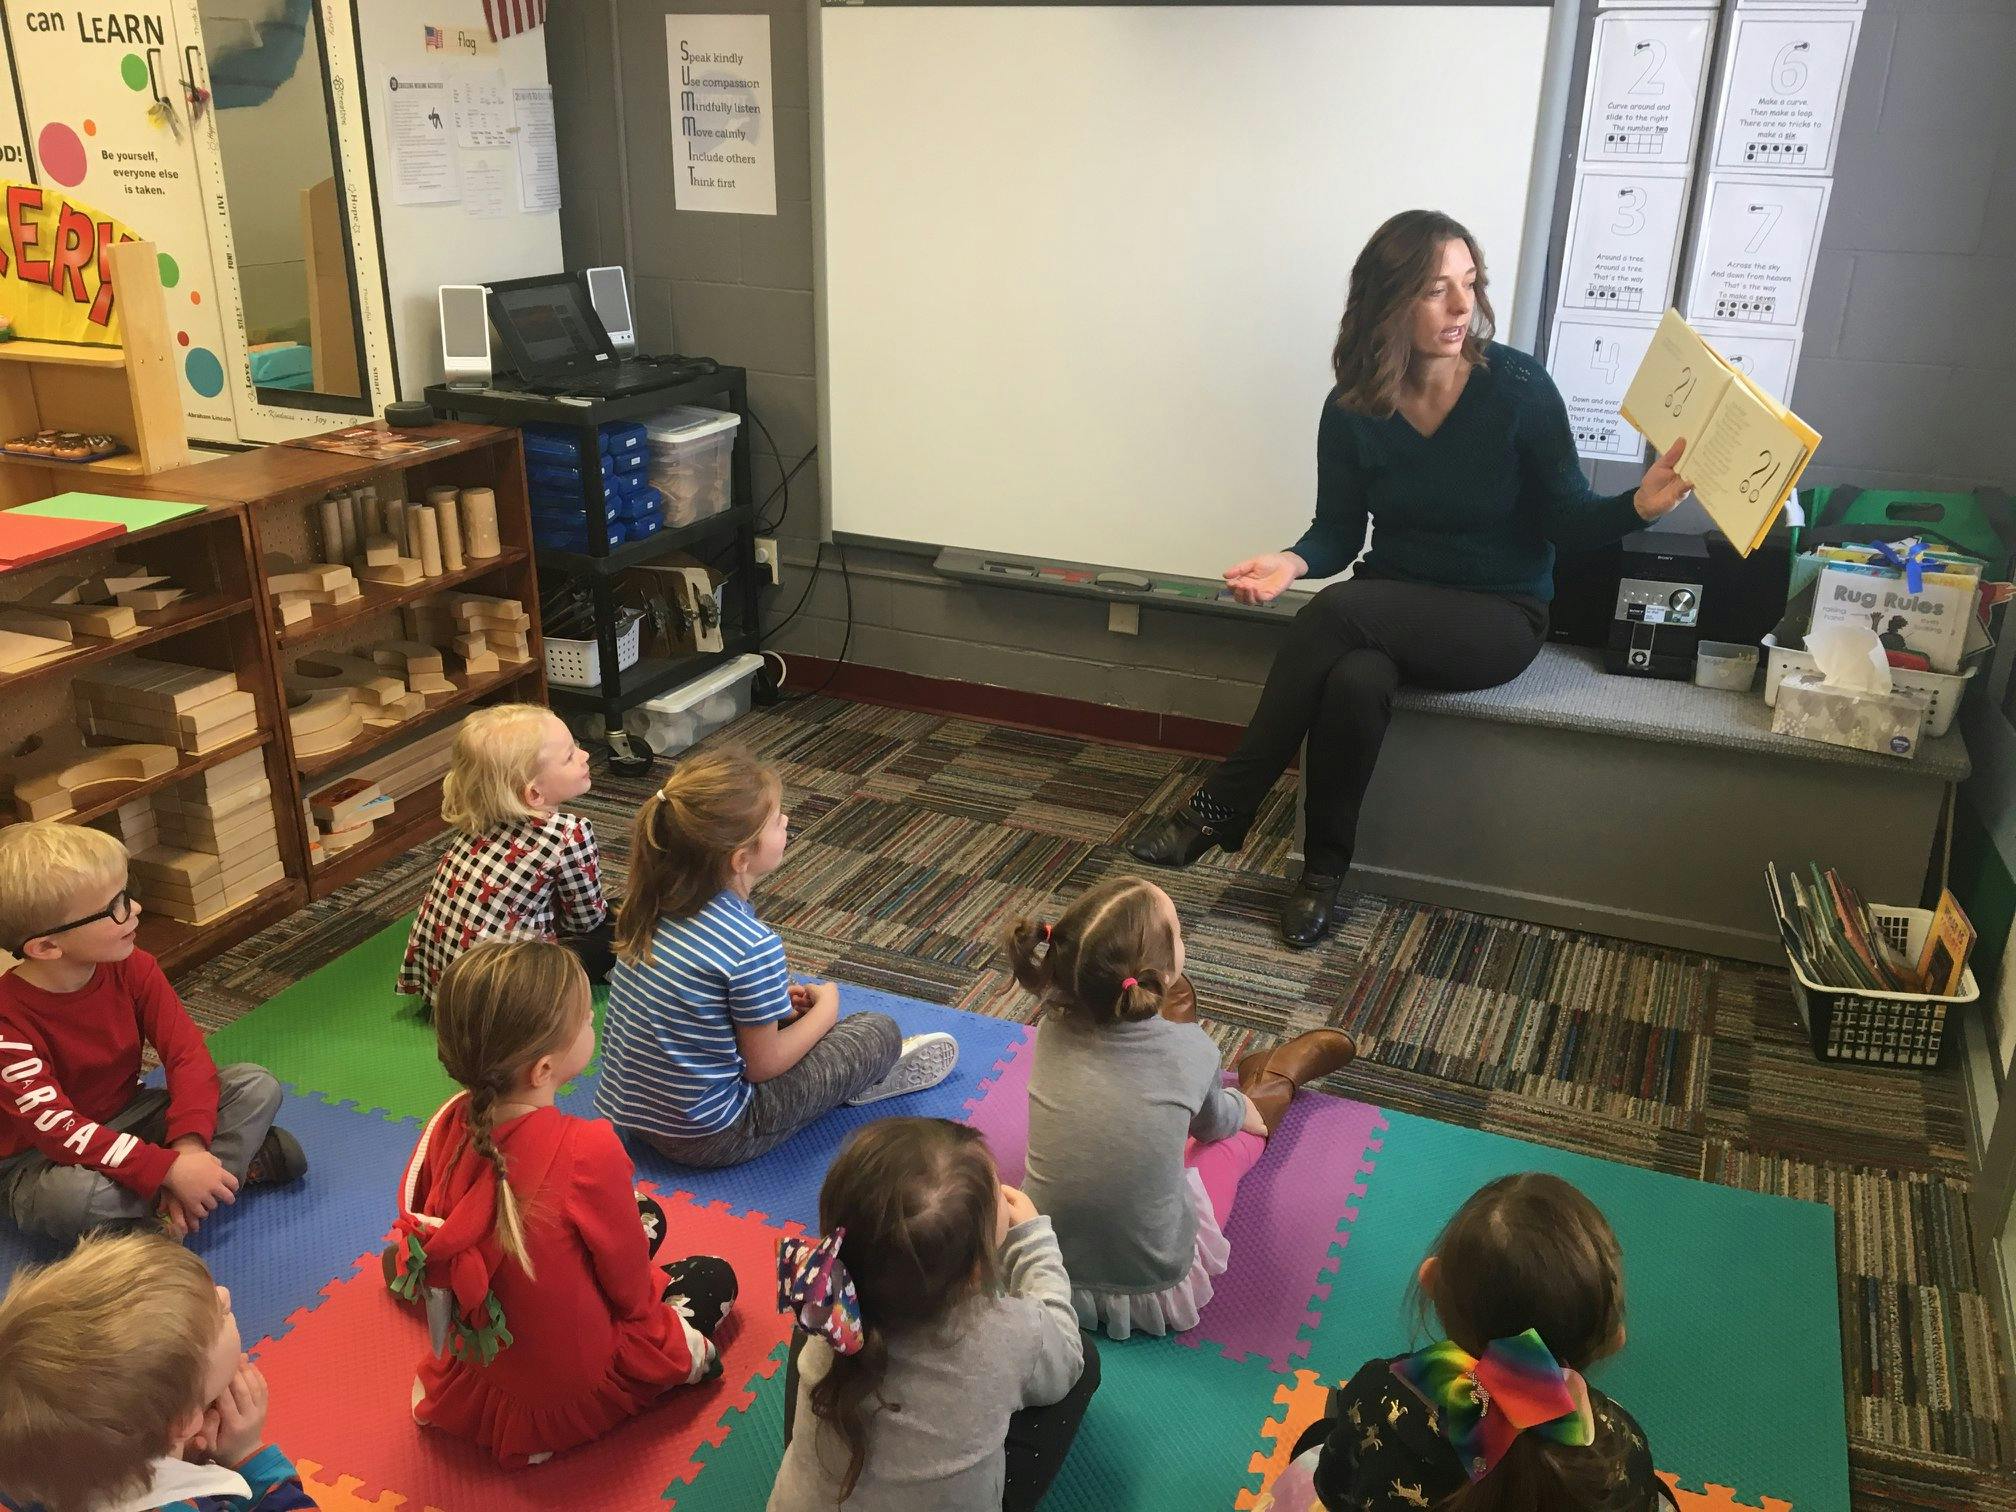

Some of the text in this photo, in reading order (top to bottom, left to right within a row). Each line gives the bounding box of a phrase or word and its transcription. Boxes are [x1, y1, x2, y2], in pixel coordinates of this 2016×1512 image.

[27, 11, 164, 45] can LEARN
[458, 31, 476, 55] flag
[680, 40, 744, 66] Speak kindly
[1628, 38, 1667, 95] 2
[1770, 40, 1810, 95] 6
[682, 66, 760, 90] Use compassion
[681, 91, 760, 114] Mindfully listen
[1607, 102, 1628, 110] Curve
[1758, 97, 1778, 106] Make
[1606, 113, 1623, 121] slide
[1649, 114, 1669, 123] right
[1750, 108, 1768, 116] Then
[1769, 109, 1789, 117] make
[1797, 109, 1813, 118] loop
[682, 116, 746, 141] Move calmly
[1612, 123, 1625, 131] The
[1655, 125, 1669, 133] two
[1739, 119, 1761, 127] There
[1788, 120, 1811, 128] tricks
[1757, 130, 1776, 138] make
[1784, 132, 1797, 140] six
[0, 146, 22, 163] D!
[101, 150, 158, 163] Be yourself,
[688, 141, 756, 164] Include others
[113, 169, 179, 179] everyone else
[687, 166, 736, 189] Think first
[124, 185, 166, 195] is taken.
[350, 194, 358, 223] Hope
[1611, 186, 1647, 236] 3
[1748, 204, 1783, 254] 7
[1596, 253, 1622, 261] Around
[1727, 261, 1752, 269] Across
[1768, 264, 1781, 272] sky
[1711, 270, 1725, 278] And
[1747, 272, 1765, 280] from
[1766, 274, 1792, 282] heaven
[1589, 283, 1597, 291] To
[1749, 283, 1761, 291] the
[1590, 336, 1620, 384] 4
[313, 415, 328, 426] Joy
[1601, 426, 1616, 434] four
[1834, 584, 1944, 616] Rug Rules
